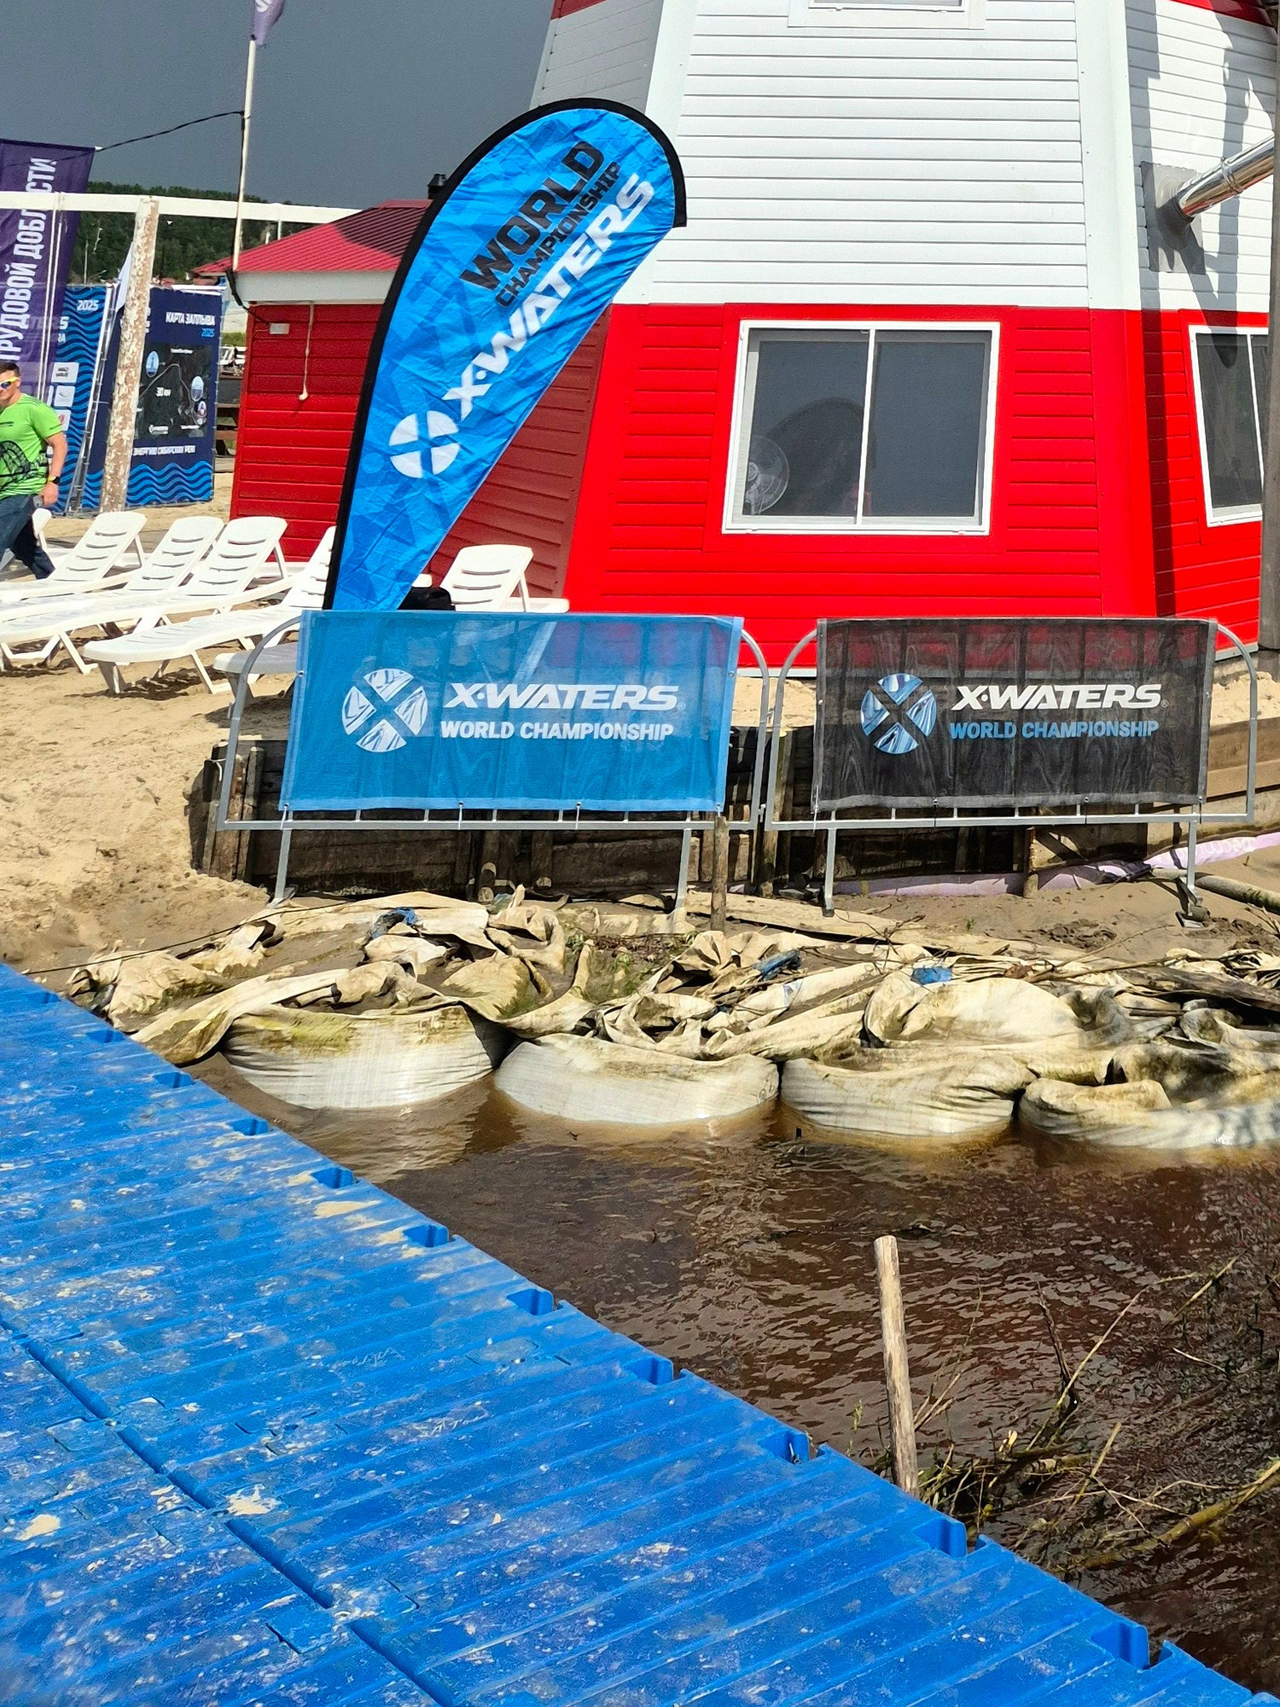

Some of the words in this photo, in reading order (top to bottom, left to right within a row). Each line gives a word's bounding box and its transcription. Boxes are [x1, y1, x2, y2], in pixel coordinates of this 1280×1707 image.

[14, 157, 57, 260] ДОБЛСТИ
[459, 140, 605, 292] WORLD
[494, 161, 622, 308] CHAMPIONSHIP
[77, 299, 99, 312] 2025
[440, 720, 515, 740] WORLD
[520, 721, 674, 741] CHAMPIONSHIP
[950, 721, 1017, 740] WORLD
[1022, 720, 1160, 739] CHAMPIONSHIP
